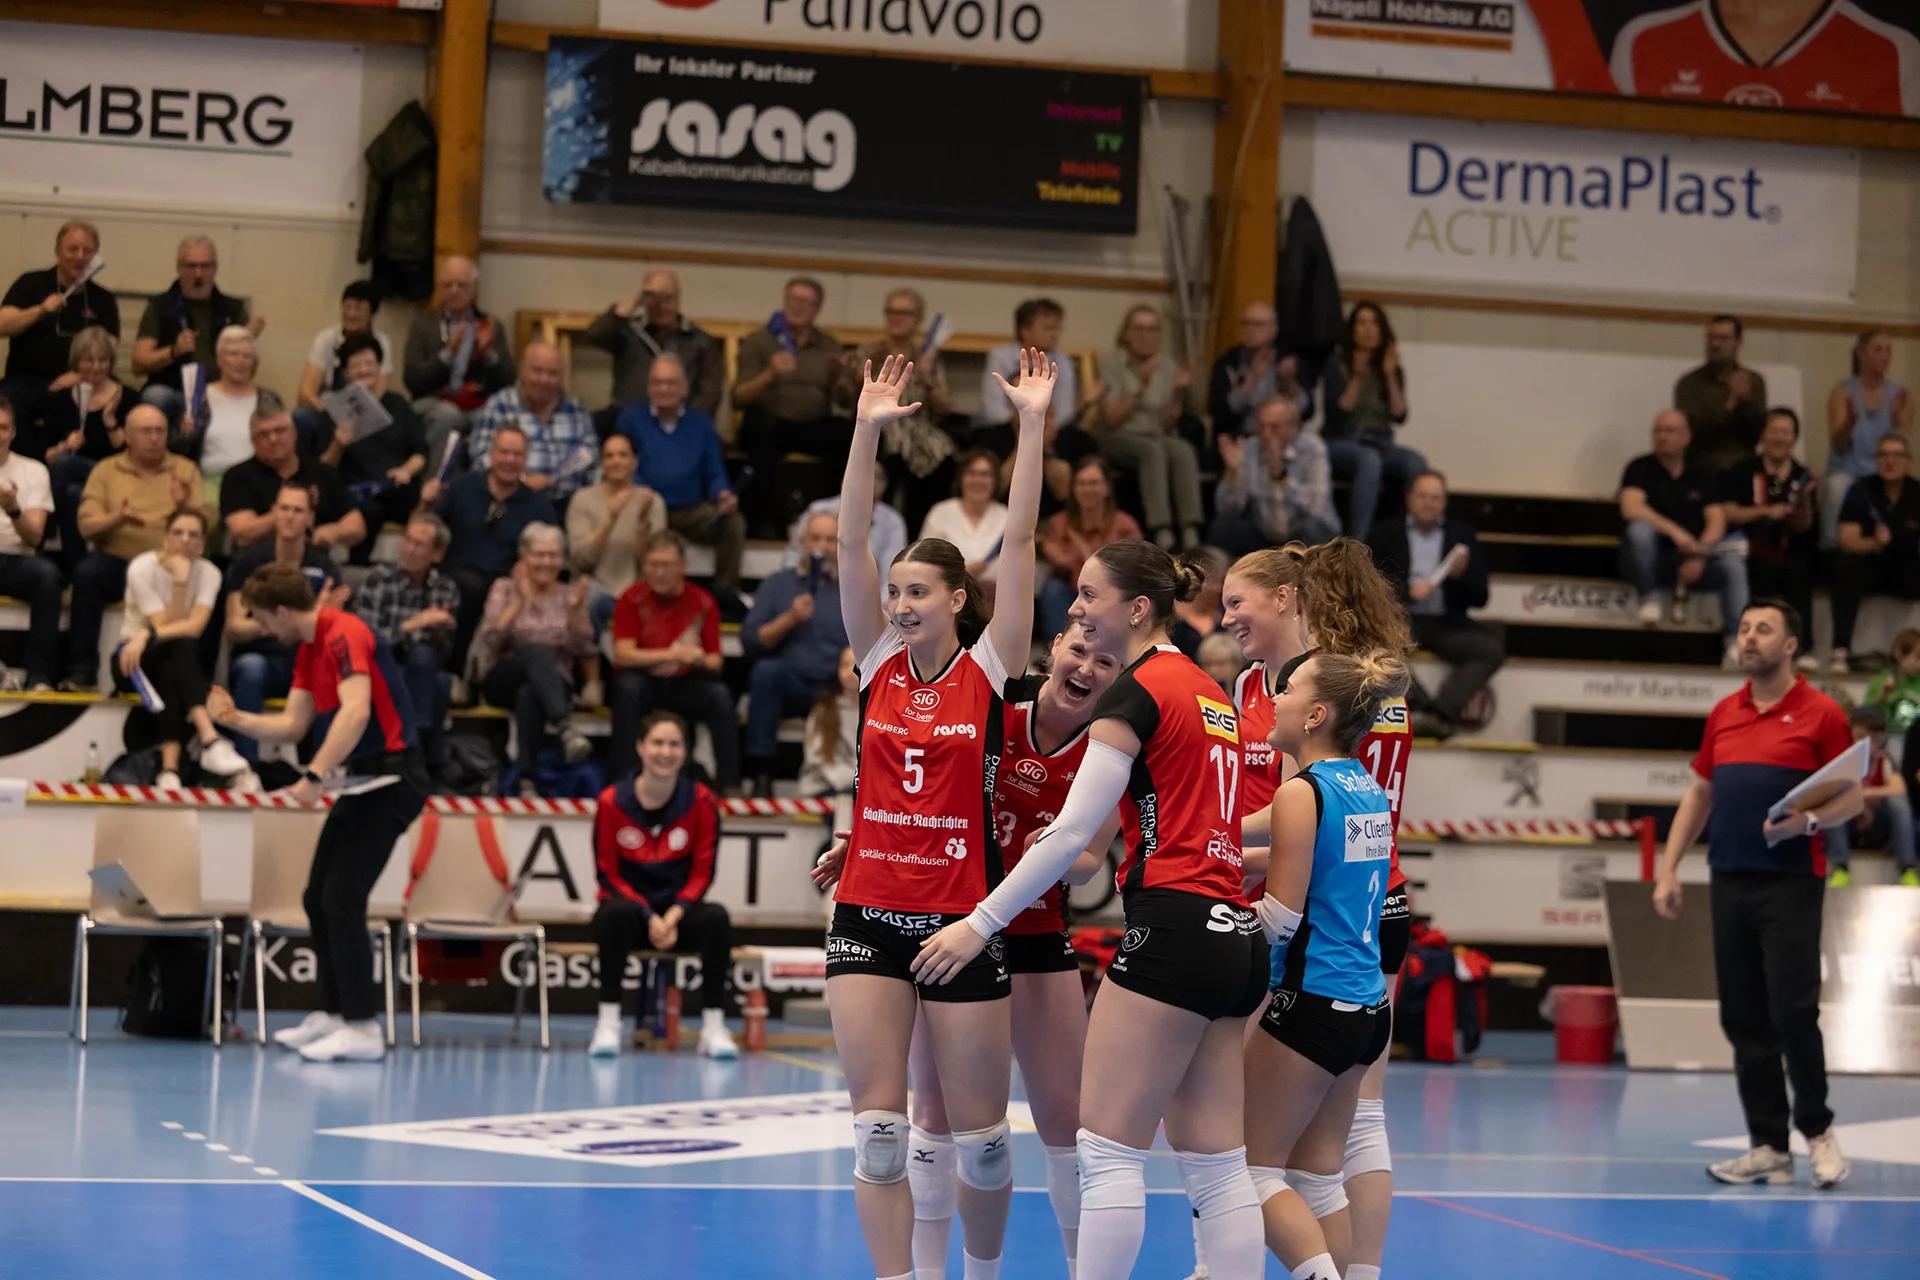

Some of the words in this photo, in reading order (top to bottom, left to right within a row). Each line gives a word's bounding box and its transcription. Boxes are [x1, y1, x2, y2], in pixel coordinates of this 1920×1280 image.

[1477, 7, 1513, 29] AG
[634, 53, 664, 75] Ihr
[668, 56, 737, 79] lokaler
[740, 60, 816, 84] Partner
[0, 77, 294, 147] LMBERG
[630, 97, 857, 192] sasag
[1095, 132, 1123, 152] TV
[628, 156, 814, 186] Kabelkommunikation
[1408, 140, 1763, 221] DermaPlast
[1405, 206, 1580, 263] ACTIVE
[1583, 677, 1636, 696] mehr
[1639, 679, 1712, 698] Marken
[912, 693, 935, 706] SIG
[904, 706, 916, 717] for
[1202, 706, 1238, 733] EKS
[933, 723, 977, 739] sasag
[902, 748, 925, 794] 5
[1019, 762, 1043, 780] SIG
[1367, 740, 1402, 812] 14
[1648, 769, 1690, 786] meh
[1006, 773, 1017, 784] for
[1018, 779, 1041, 795] better
[1209, 744, 1239, 824] 17
[913, 814, 969, 830] Nachrichten
[1143, 793, 1157, 861] DermaPla
[859, 848, 886, 861] spitäler
[887, 853, 949, 867] schaffhausen
[867, 907, 942, 930] GASSER
[900, 926, 944, 937] AUTOMO
